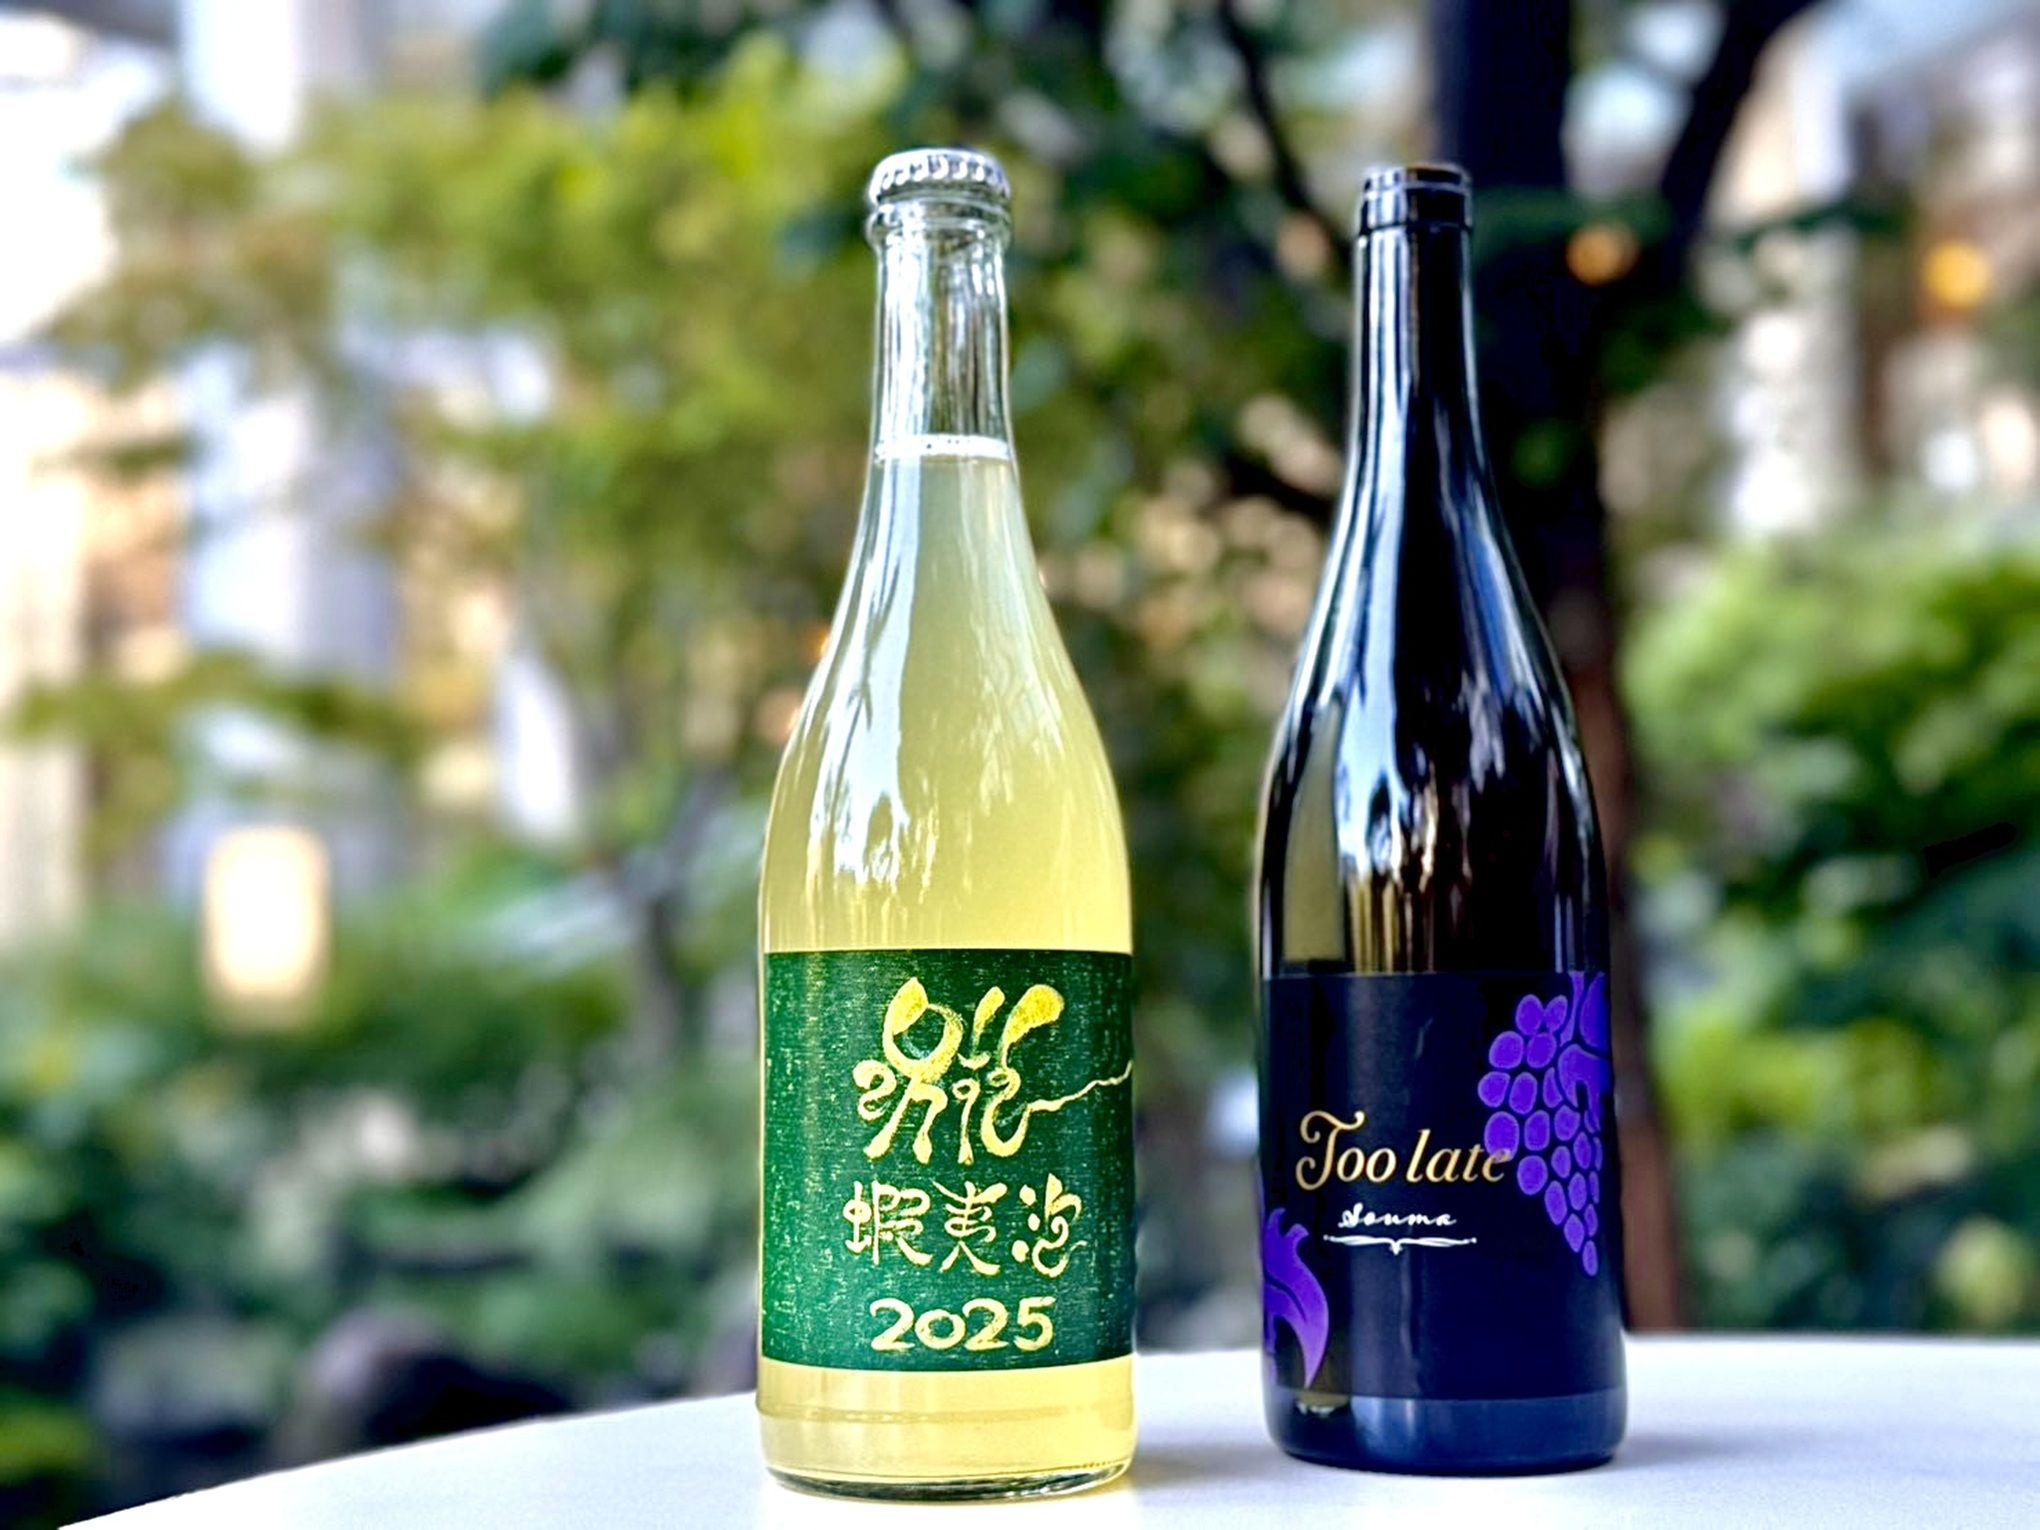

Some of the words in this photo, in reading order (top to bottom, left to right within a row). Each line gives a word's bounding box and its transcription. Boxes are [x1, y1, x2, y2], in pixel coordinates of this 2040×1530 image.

[1295, 1109, 1398, 1190] Too
[1405, 1129, 1512, 1183] late
[869, 1296, 1057, 1353] 2025
